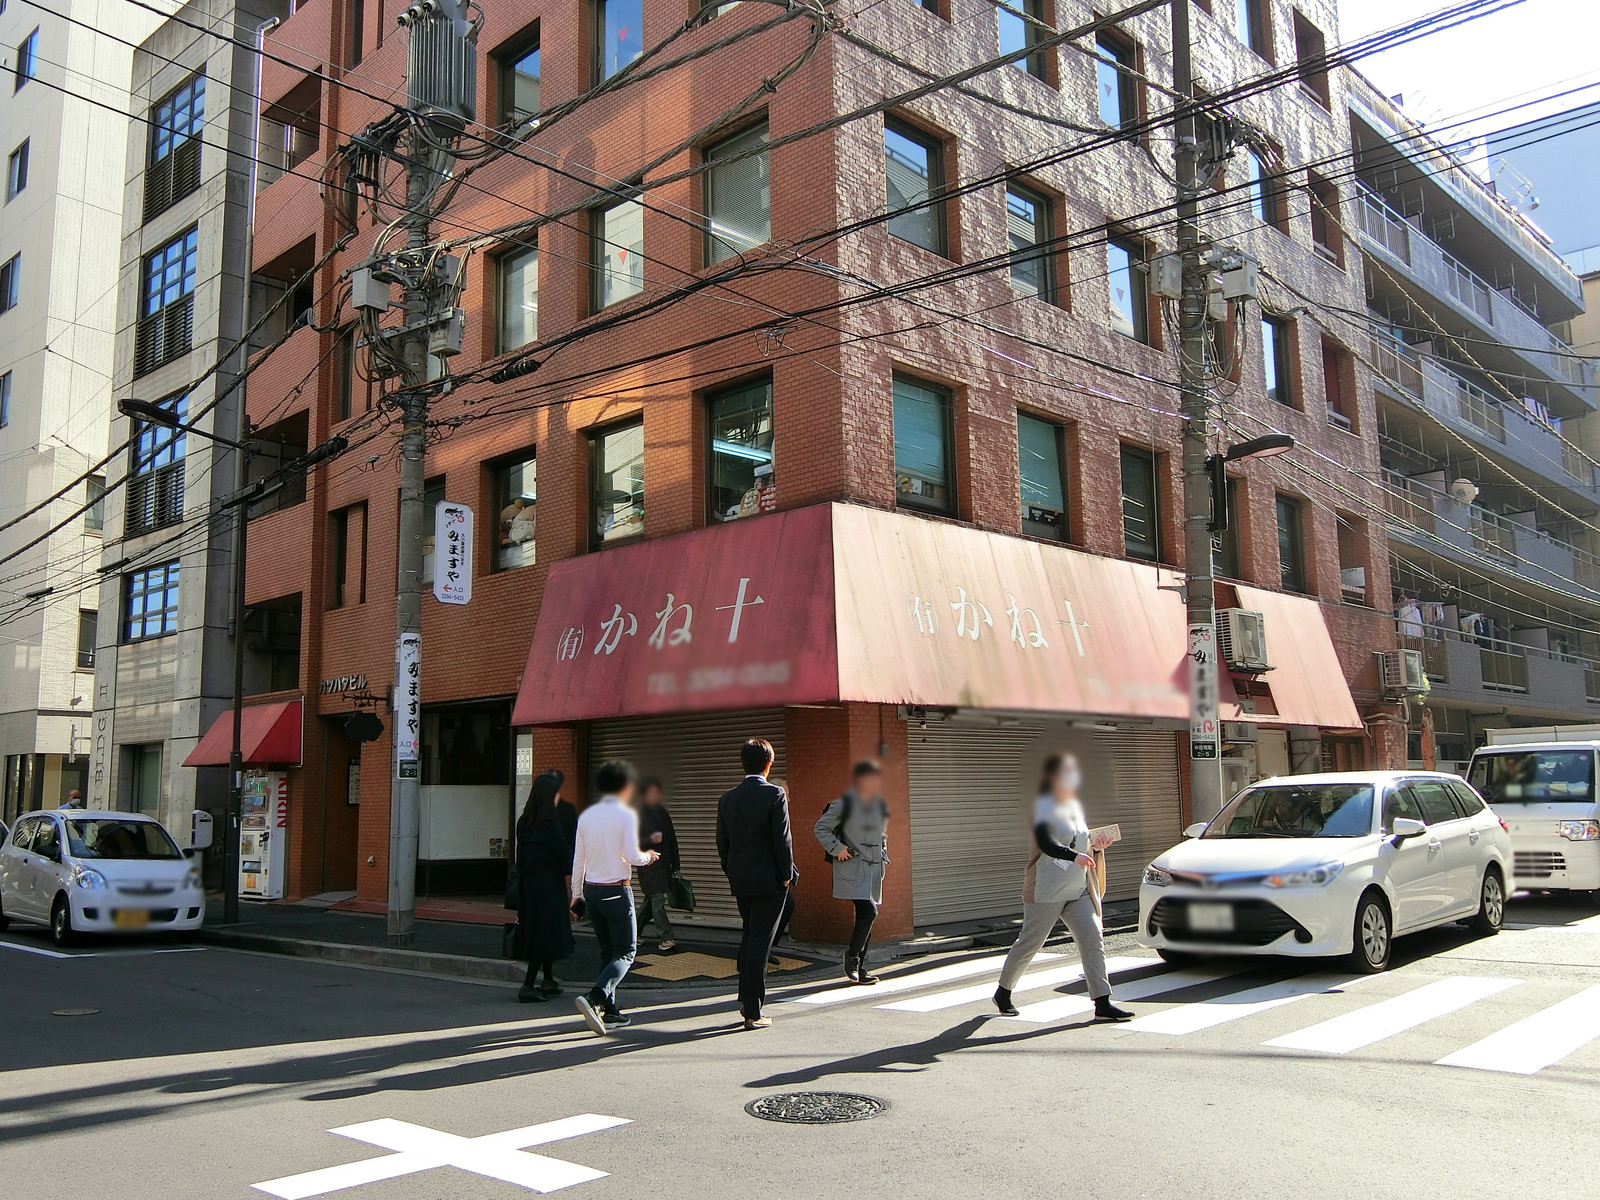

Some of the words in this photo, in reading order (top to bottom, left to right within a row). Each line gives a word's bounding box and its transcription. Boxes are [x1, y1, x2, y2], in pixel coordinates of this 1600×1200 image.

[446, 529, 460, 583] みますや
[406, 661, 421, 734] みますや
